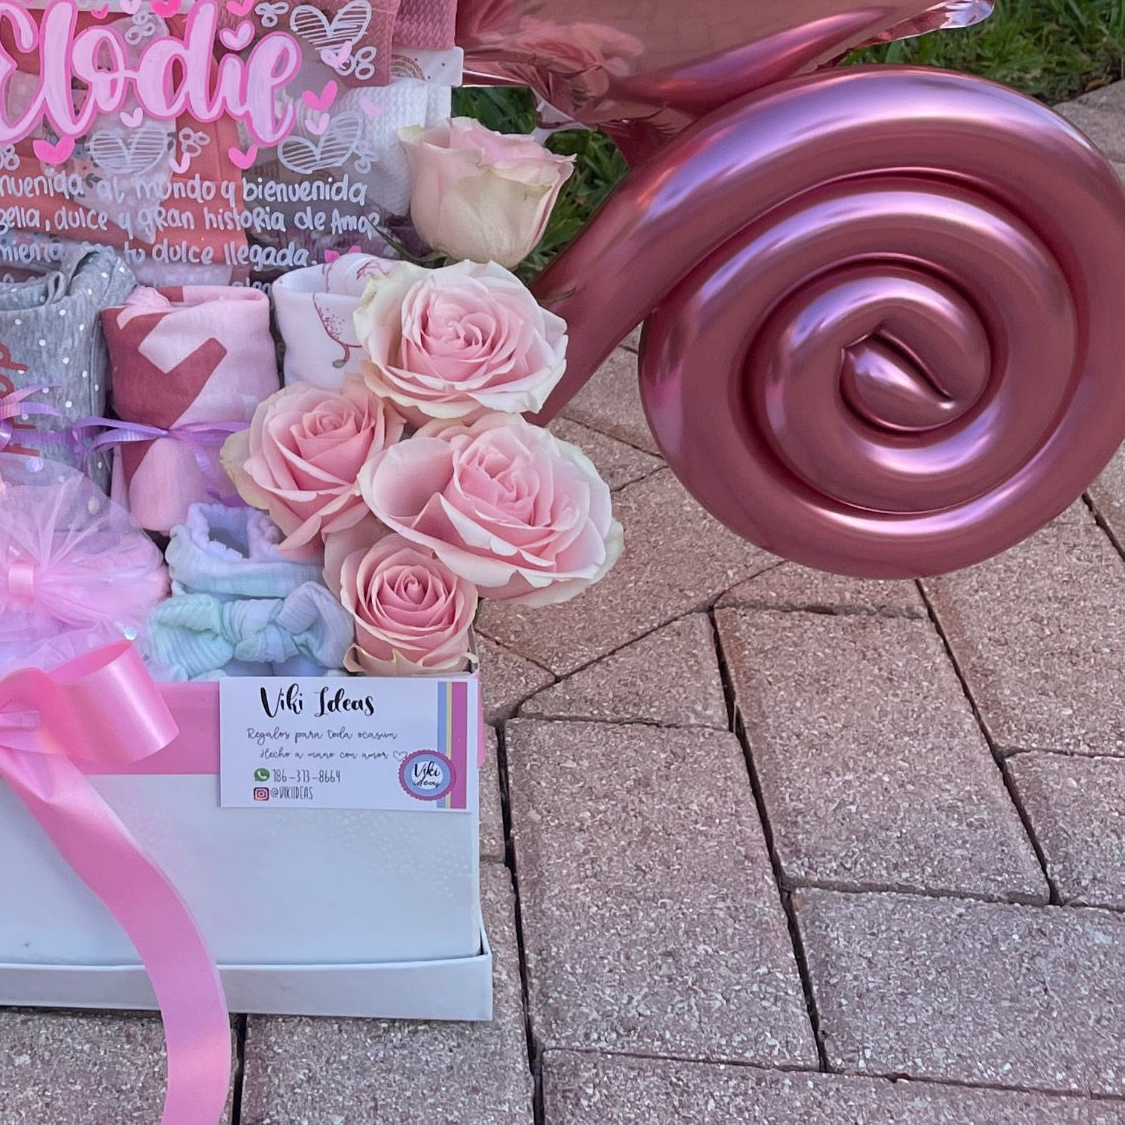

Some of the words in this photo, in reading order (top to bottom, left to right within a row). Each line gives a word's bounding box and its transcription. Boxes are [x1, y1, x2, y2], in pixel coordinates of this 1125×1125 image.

[96, 175, 124, 204] al
[135, 174, 216, 204] mundo
[243, 174, 369, 206] bienvenida
[54, 206, 108, 231] dulce
[118, 214, 134, 240] y
[293, 206, 325, 231] de
[152, 238, 213, 264] dulce
[260, 683, 303, 718] Viki
[313, 686, 375, 718] Ideas
[246, 726, 291, 745] Regalos
[294, 729, 324, 744] para
[327, 726, 354, 739] toda
[259, 746, 291, 760] Hecho
[294, 751, 304, 760] a
[307, 751, 336, 760] mano
[339, 751, 359, 761] con
[361, 751, 389, 761] amor
[414, 761, 441, 777] Viki
[412, 775, 441, 788] ideas
